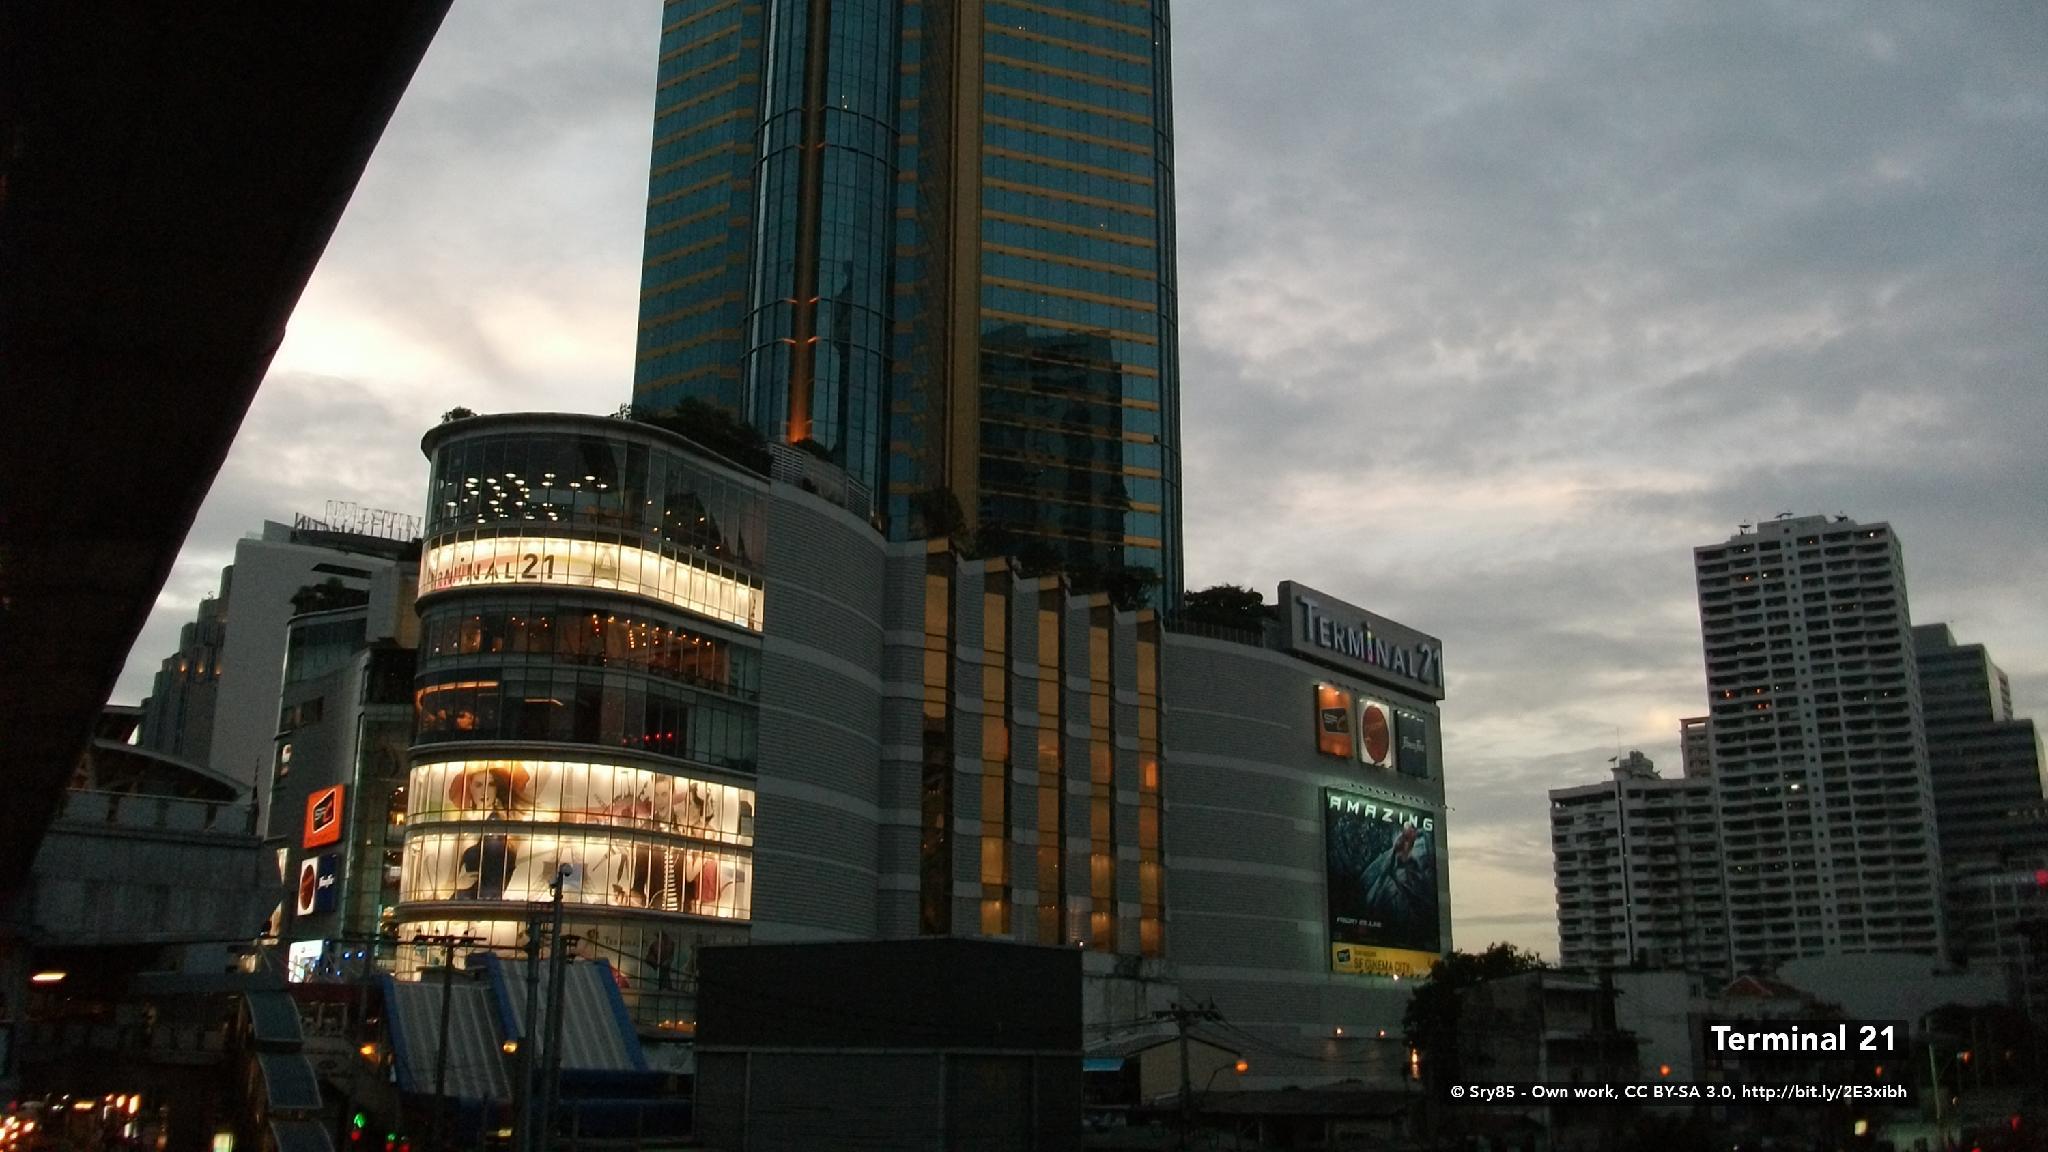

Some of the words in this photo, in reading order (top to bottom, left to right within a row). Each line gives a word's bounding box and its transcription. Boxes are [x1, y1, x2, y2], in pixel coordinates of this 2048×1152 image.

[521, 553, 554, 580] 21
[1416, 643, 1442, 688] 21
[1328, 795, 1433, 832] AMAZING
